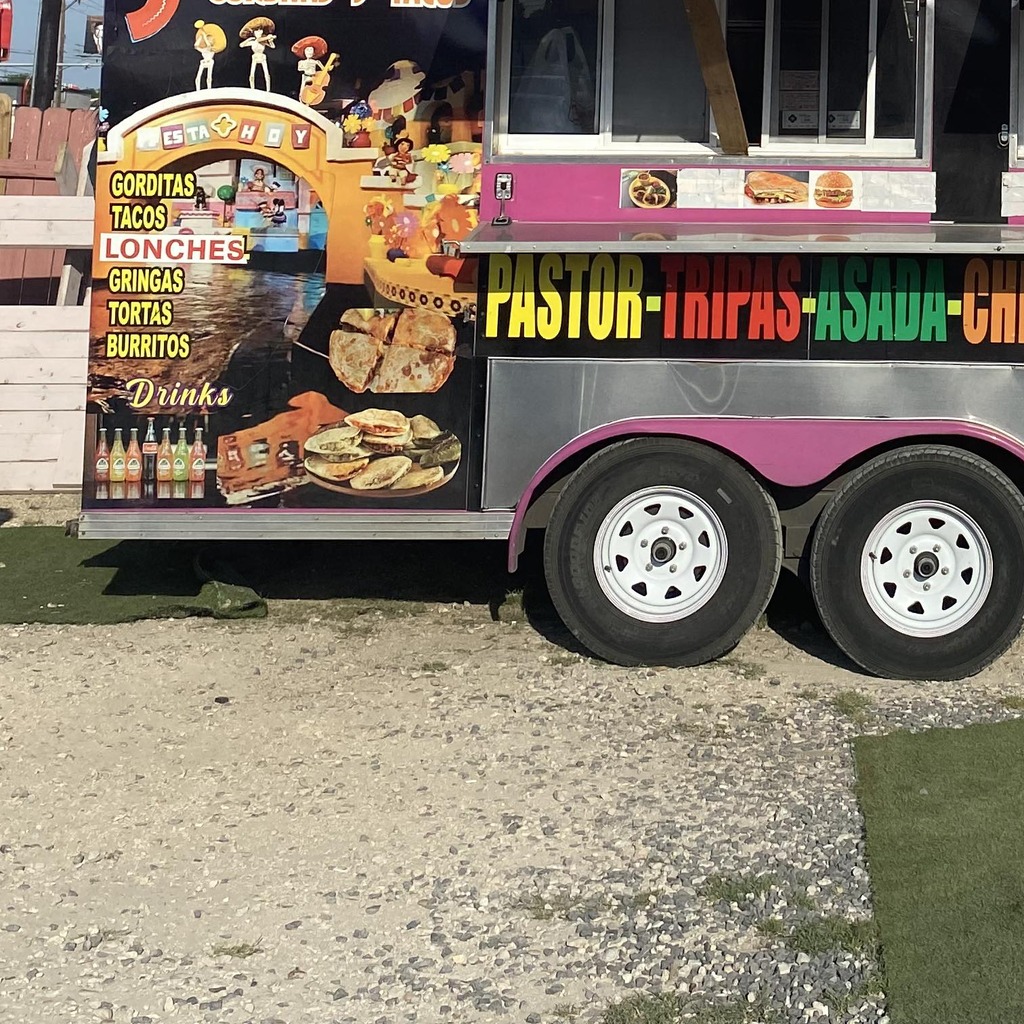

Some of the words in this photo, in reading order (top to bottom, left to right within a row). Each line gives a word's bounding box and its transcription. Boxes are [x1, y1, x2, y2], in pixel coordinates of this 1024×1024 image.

[240, 125, 308, 144] HOY
[110, 171, 197, 198] GORDITAS
[111, 204, 168, 230] TACOS
[104, 236, 245, 261] LONCHES
[107, 267, 185, 294] GRINGAS
[107, 299, 174, 326] TORTAS
[105, 333, 191, 359] BURRITOS
[125, 378, 233, 408] Drinks
